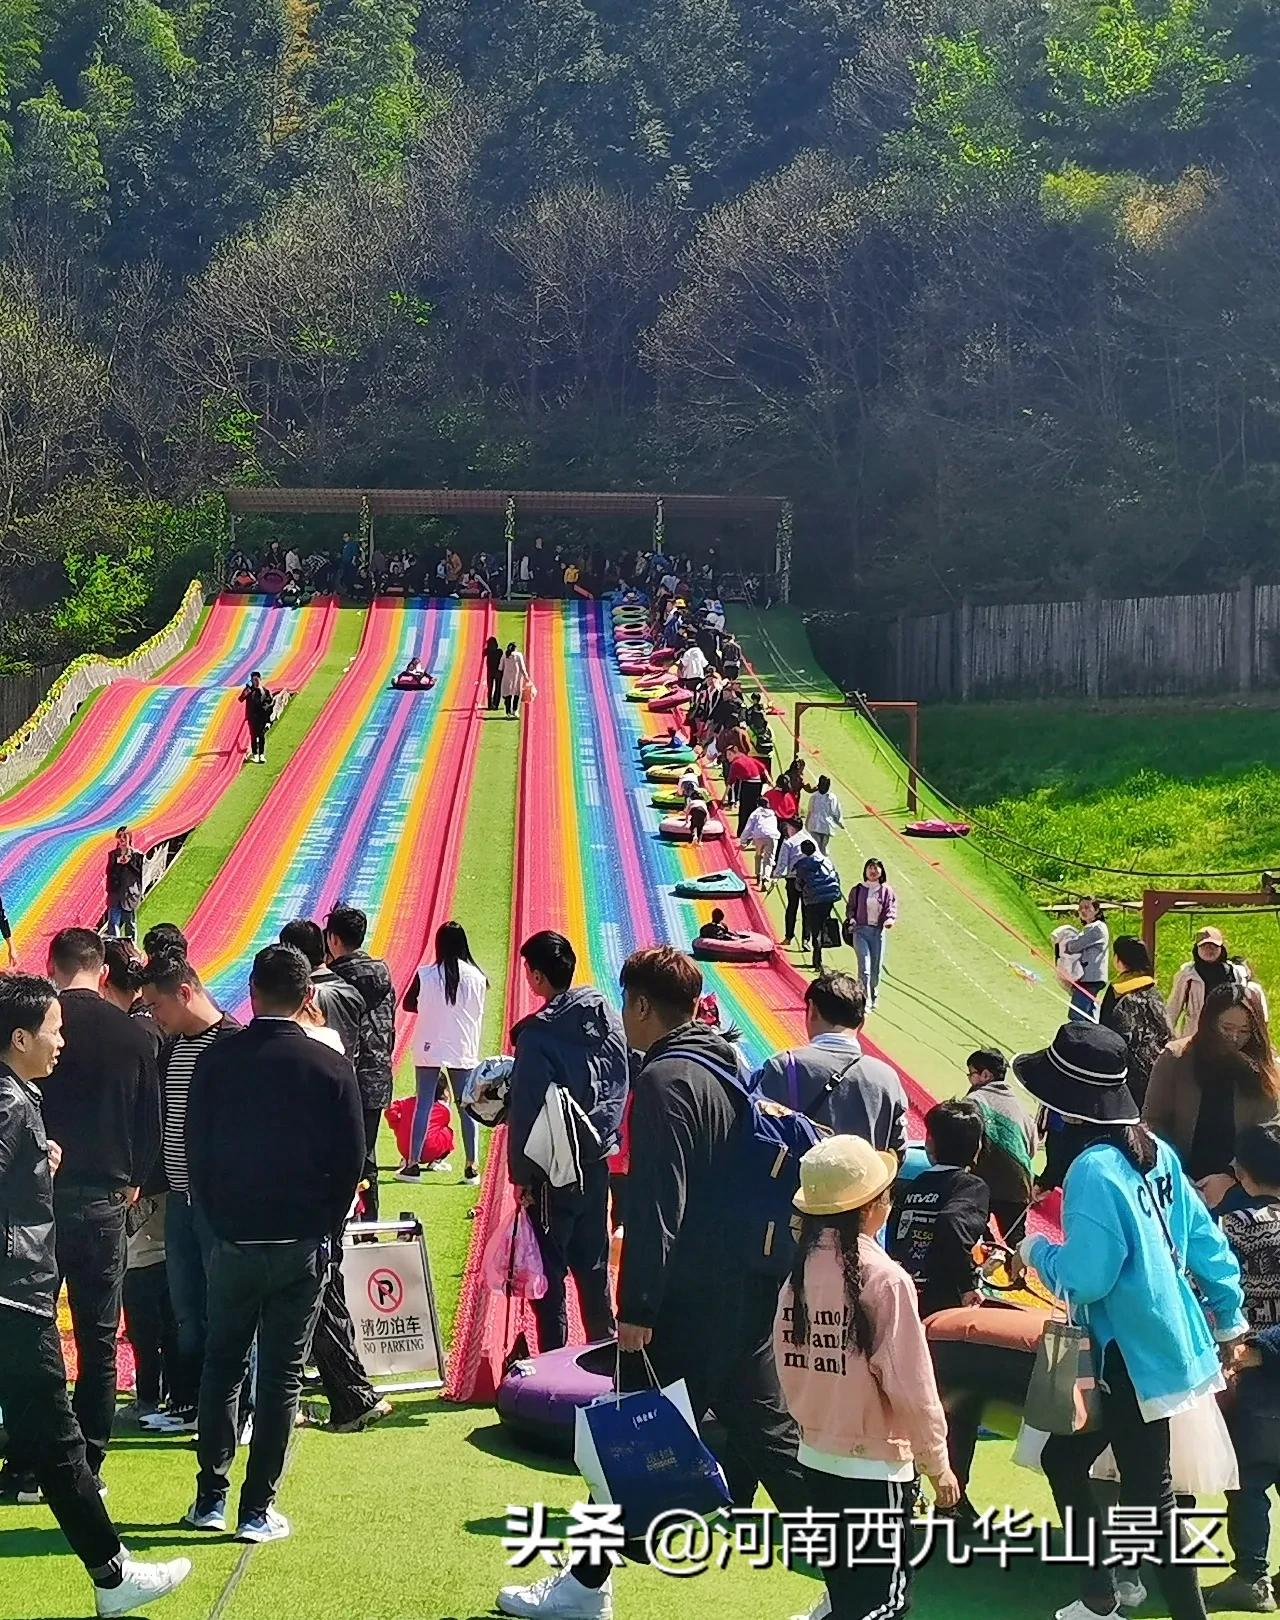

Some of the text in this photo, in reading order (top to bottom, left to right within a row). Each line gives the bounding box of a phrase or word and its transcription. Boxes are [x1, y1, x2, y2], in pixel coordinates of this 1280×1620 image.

[361, 1315, 421, 1337] 请勿泊车
[363, 1339, 424, 1354] NO PARKING
